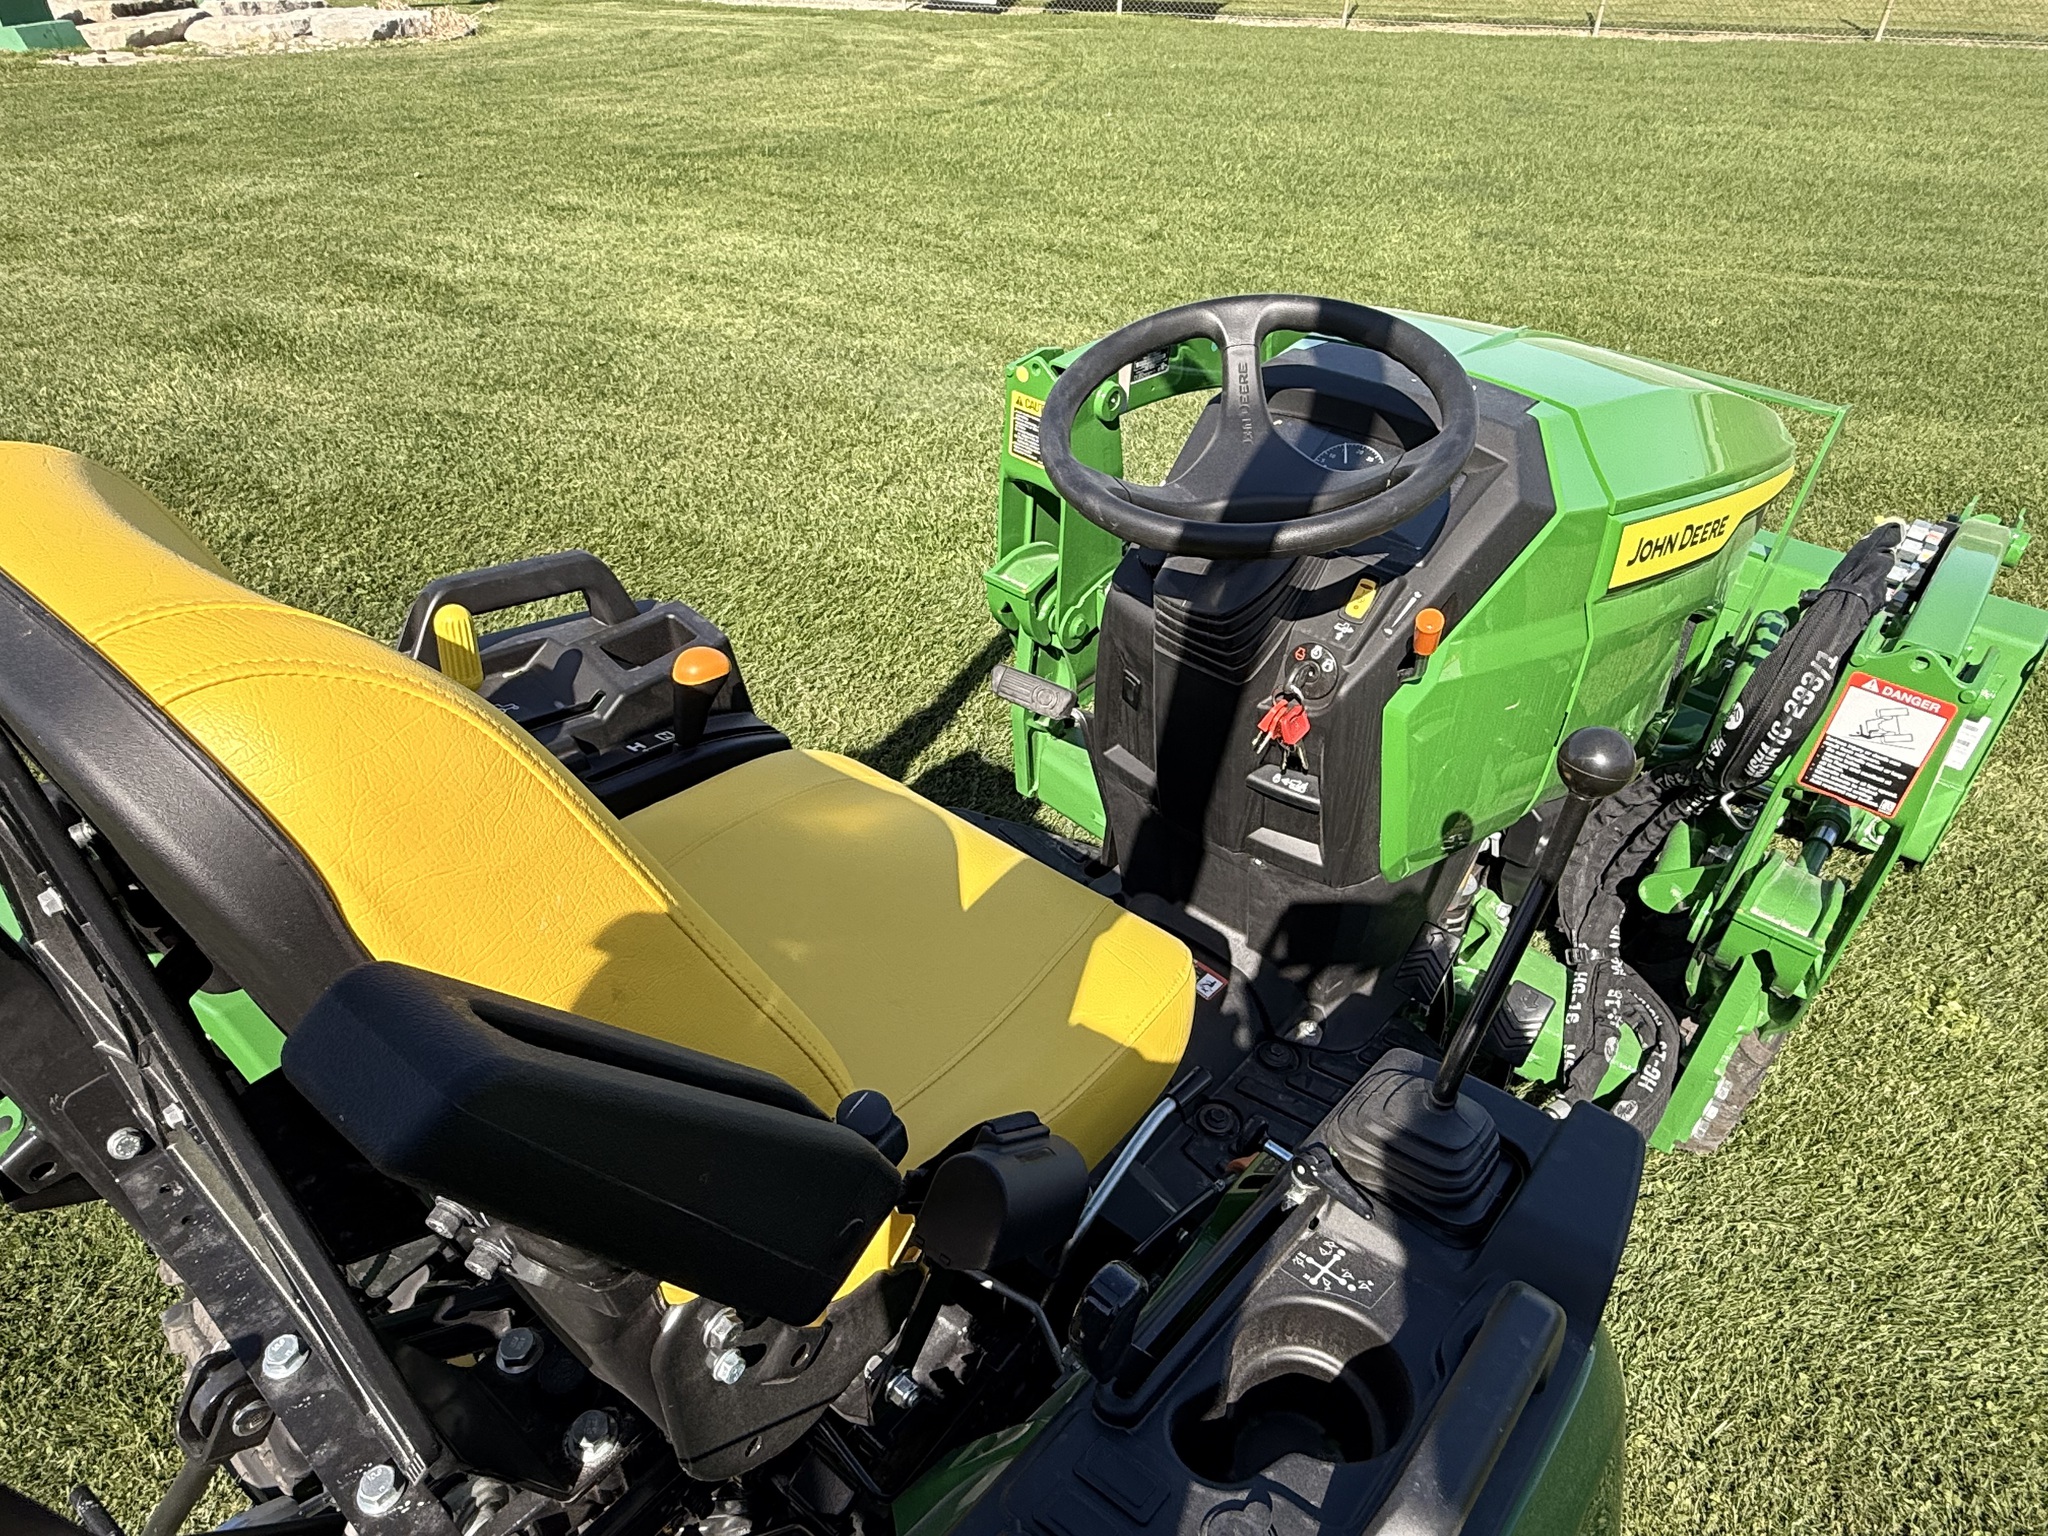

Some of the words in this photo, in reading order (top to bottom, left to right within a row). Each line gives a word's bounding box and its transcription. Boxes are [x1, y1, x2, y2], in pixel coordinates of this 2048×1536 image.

[1238, 362, 1250, 415] DEERE
[1626, 532, 1680, 567] JOHN
[1678, 515, 1730, 551] DEERE
[1766, 650, 1839, 747] IC-293/1
[1881, 685, 1942, 714] DANGER
[626, 742, 647, 752] H
